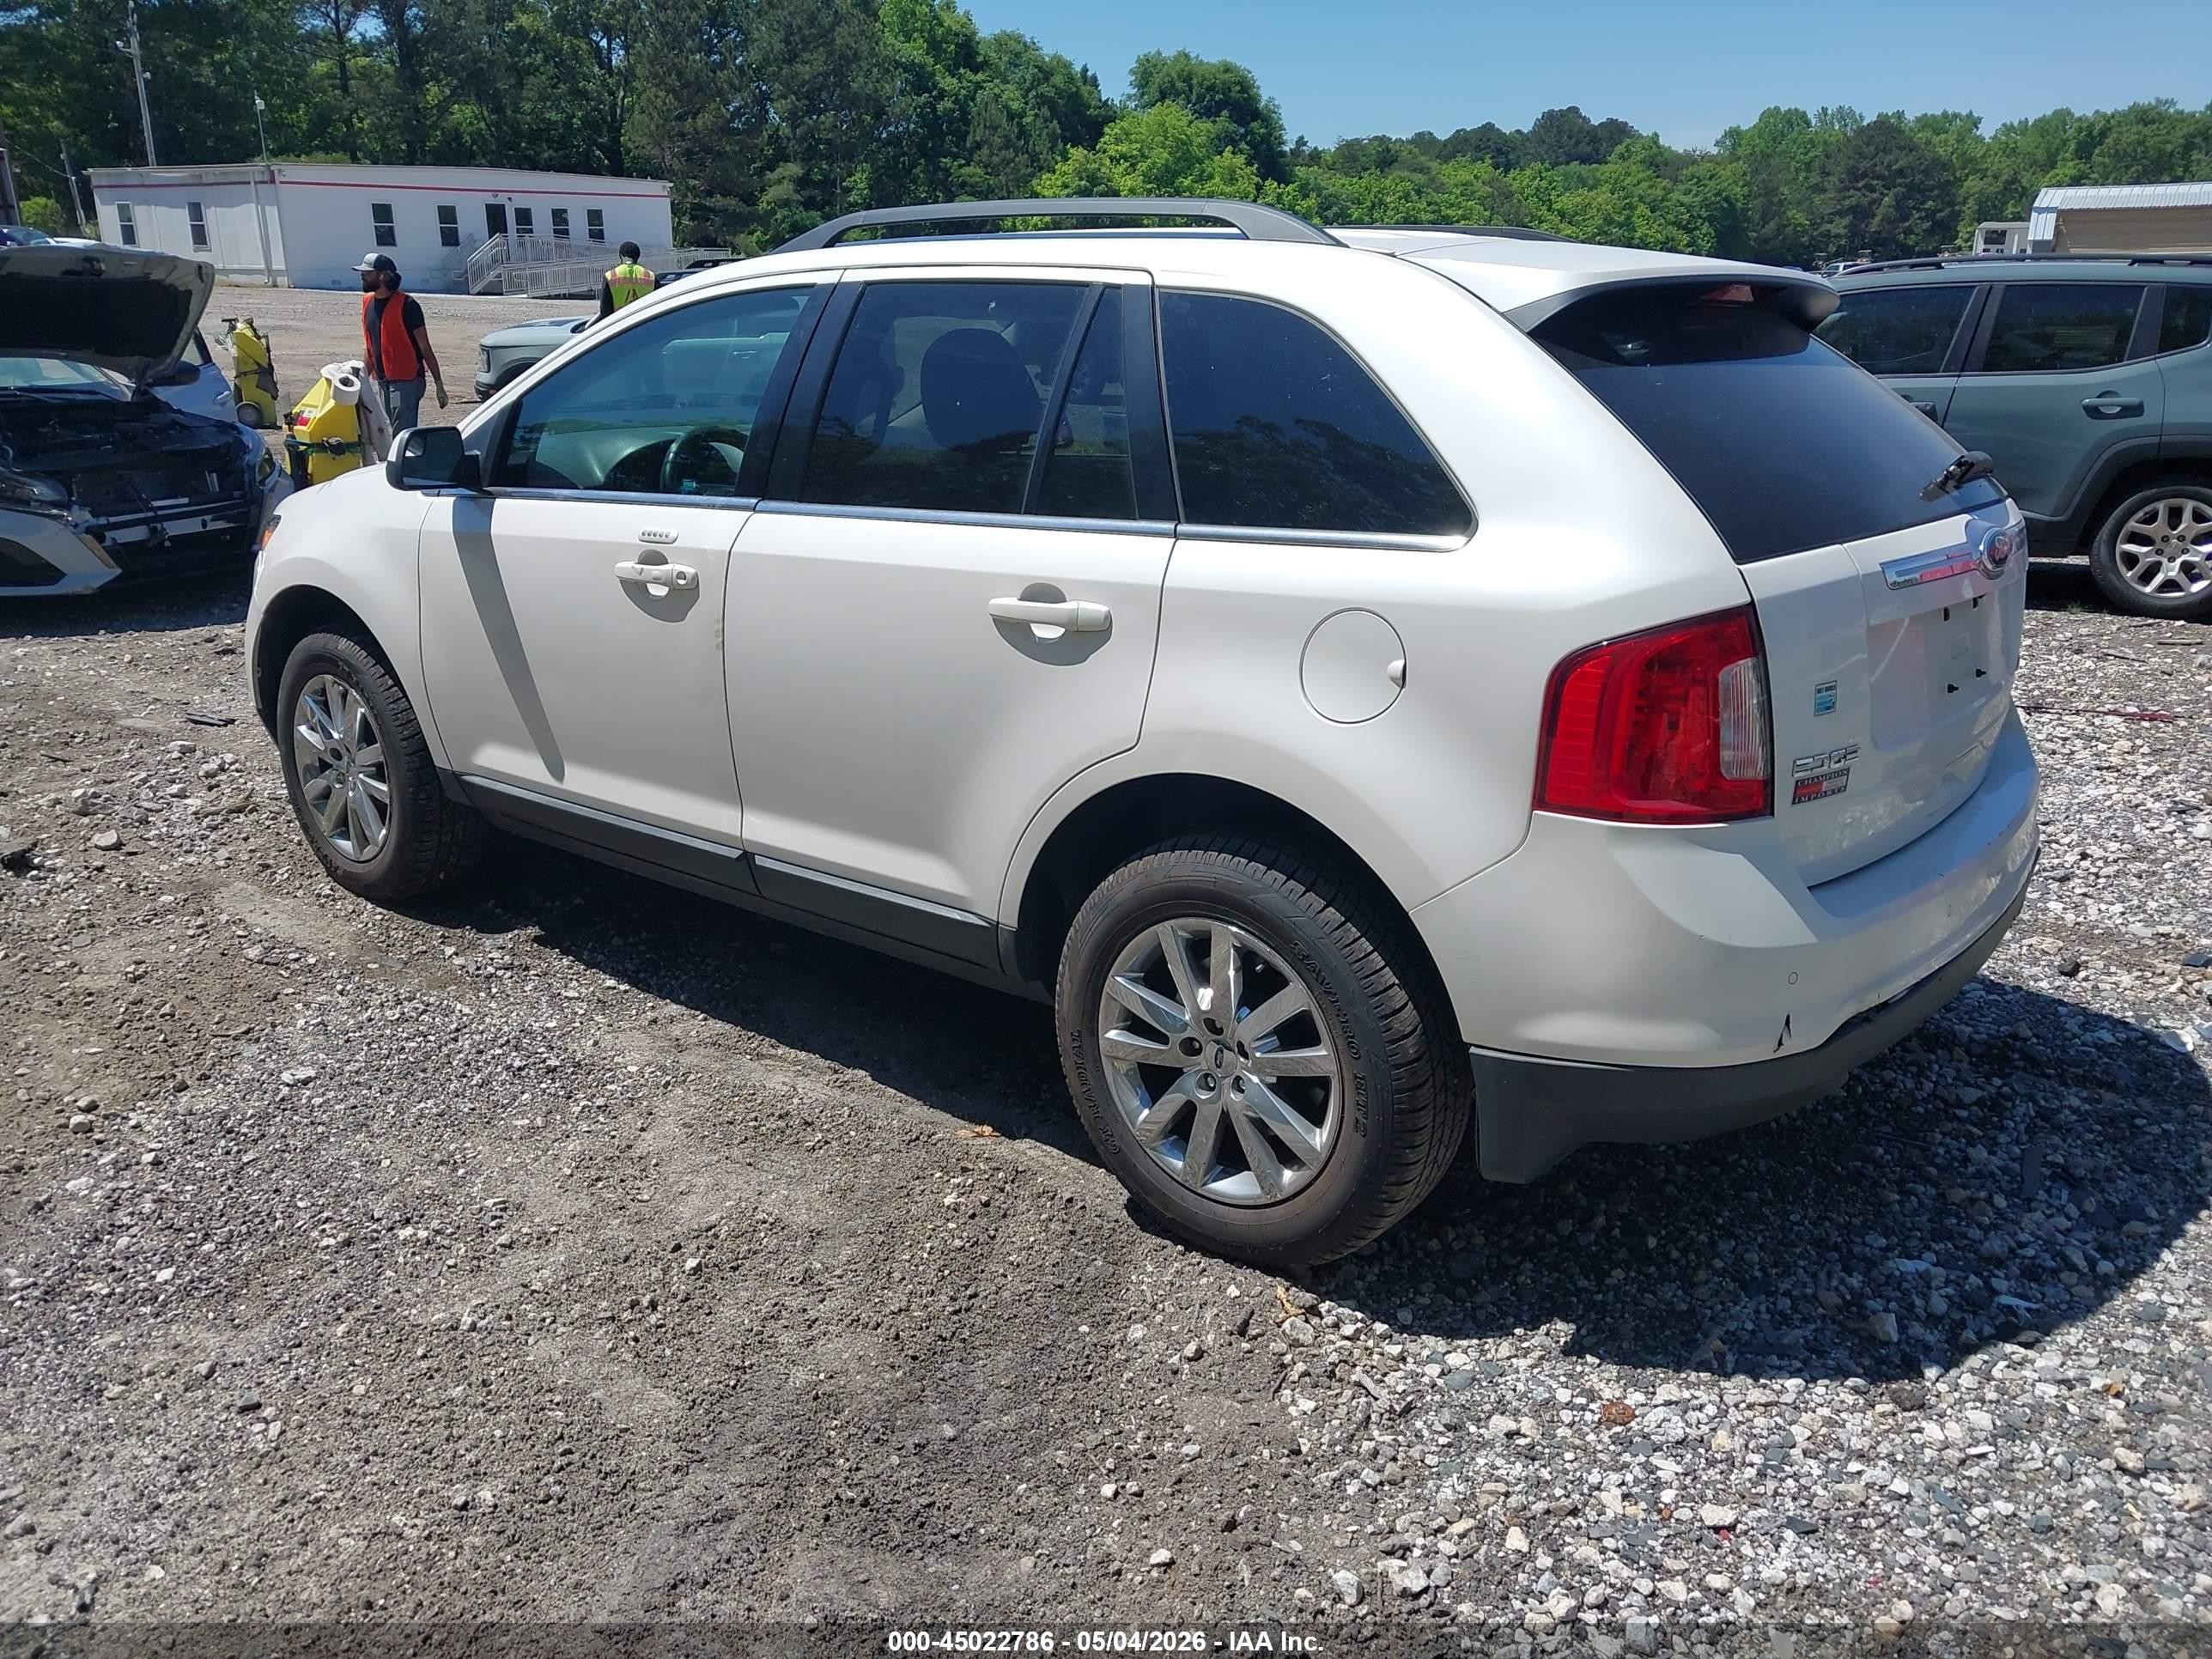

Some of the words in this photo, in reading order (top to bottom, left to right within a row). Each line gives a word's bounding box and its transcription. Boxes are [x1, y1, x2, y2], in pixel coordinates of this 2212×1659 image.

[1792, 744, 1861, 777] EDGE
[1797, 768, 1849, 787] CHAMPION
[1794, 786, 1846, 804] IMPORTS
[1070, 1027, 1103, 1121] RADIAL
